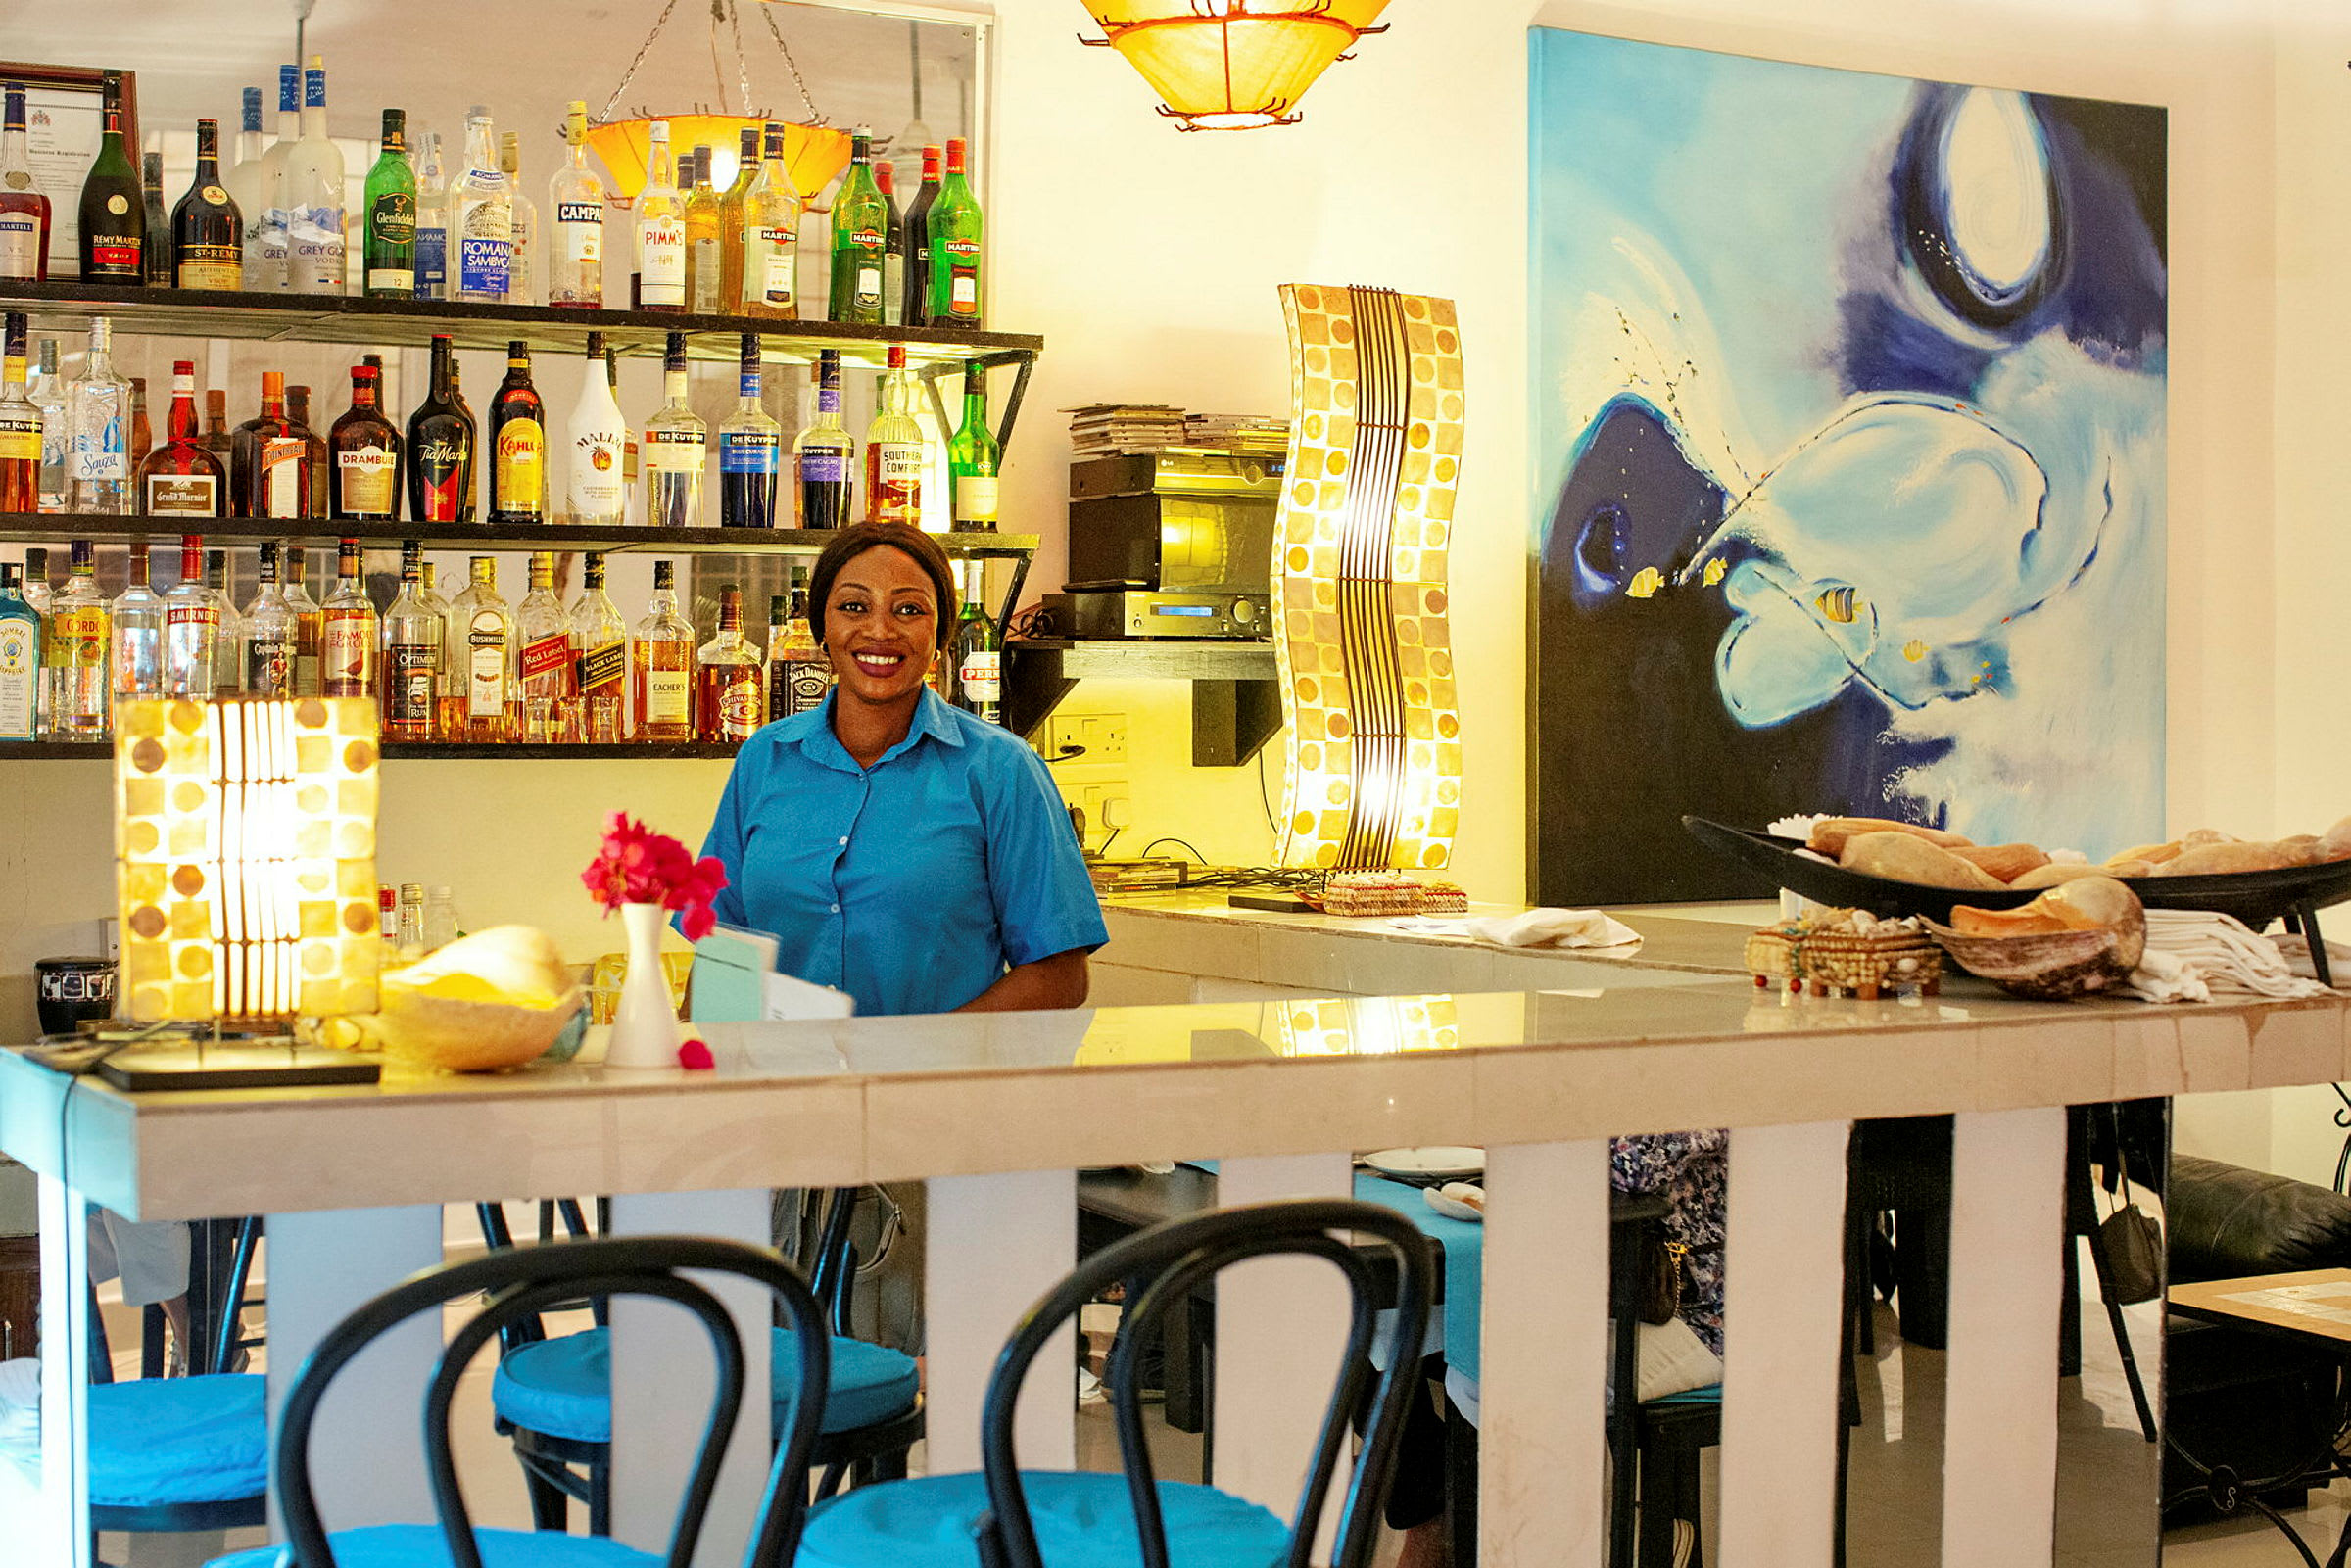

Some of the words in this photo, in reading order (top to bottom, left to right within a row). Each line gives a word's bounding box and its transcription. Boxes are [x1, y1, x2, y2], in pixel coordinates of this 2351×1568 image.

[561, 205, 602, 221] CAMPA
[646, 229, 684, 246] PIMM'S
[762, 231, 796, 242] MARTINI
[853, 234, 886, 245] MARTINI
[298, 245, 324, 256] GREY
[947, 243, 980, 252] MARTINI
[264, 249, 288, 259] GREY
[393, 278, 403, 287] 12
[672, 432, 703, 442] KUYPER
[744, 435, 777, 445] KUYPER
[417, 444, 438, 462] Tia
[434, 446, 467, 463] Mari
[81, 454, 118, 476] Sauza
[343, 454, 395, 465] DRAMBUIE
[156, 492, 178, 502] Grand
[178, 492, 209, 502] Marnier
[170, 610, 219, 622] SMIRNOFF
[470, 635, 504, 643] BUSHMILLS
[524, 652, 543, 666] Red
[543, 643, 565, 659] Label
[789, 669, 805, 683] JACK
[966, 669, 1000, 679] PERN
[652, 683, 685, 691] EACHER'S
